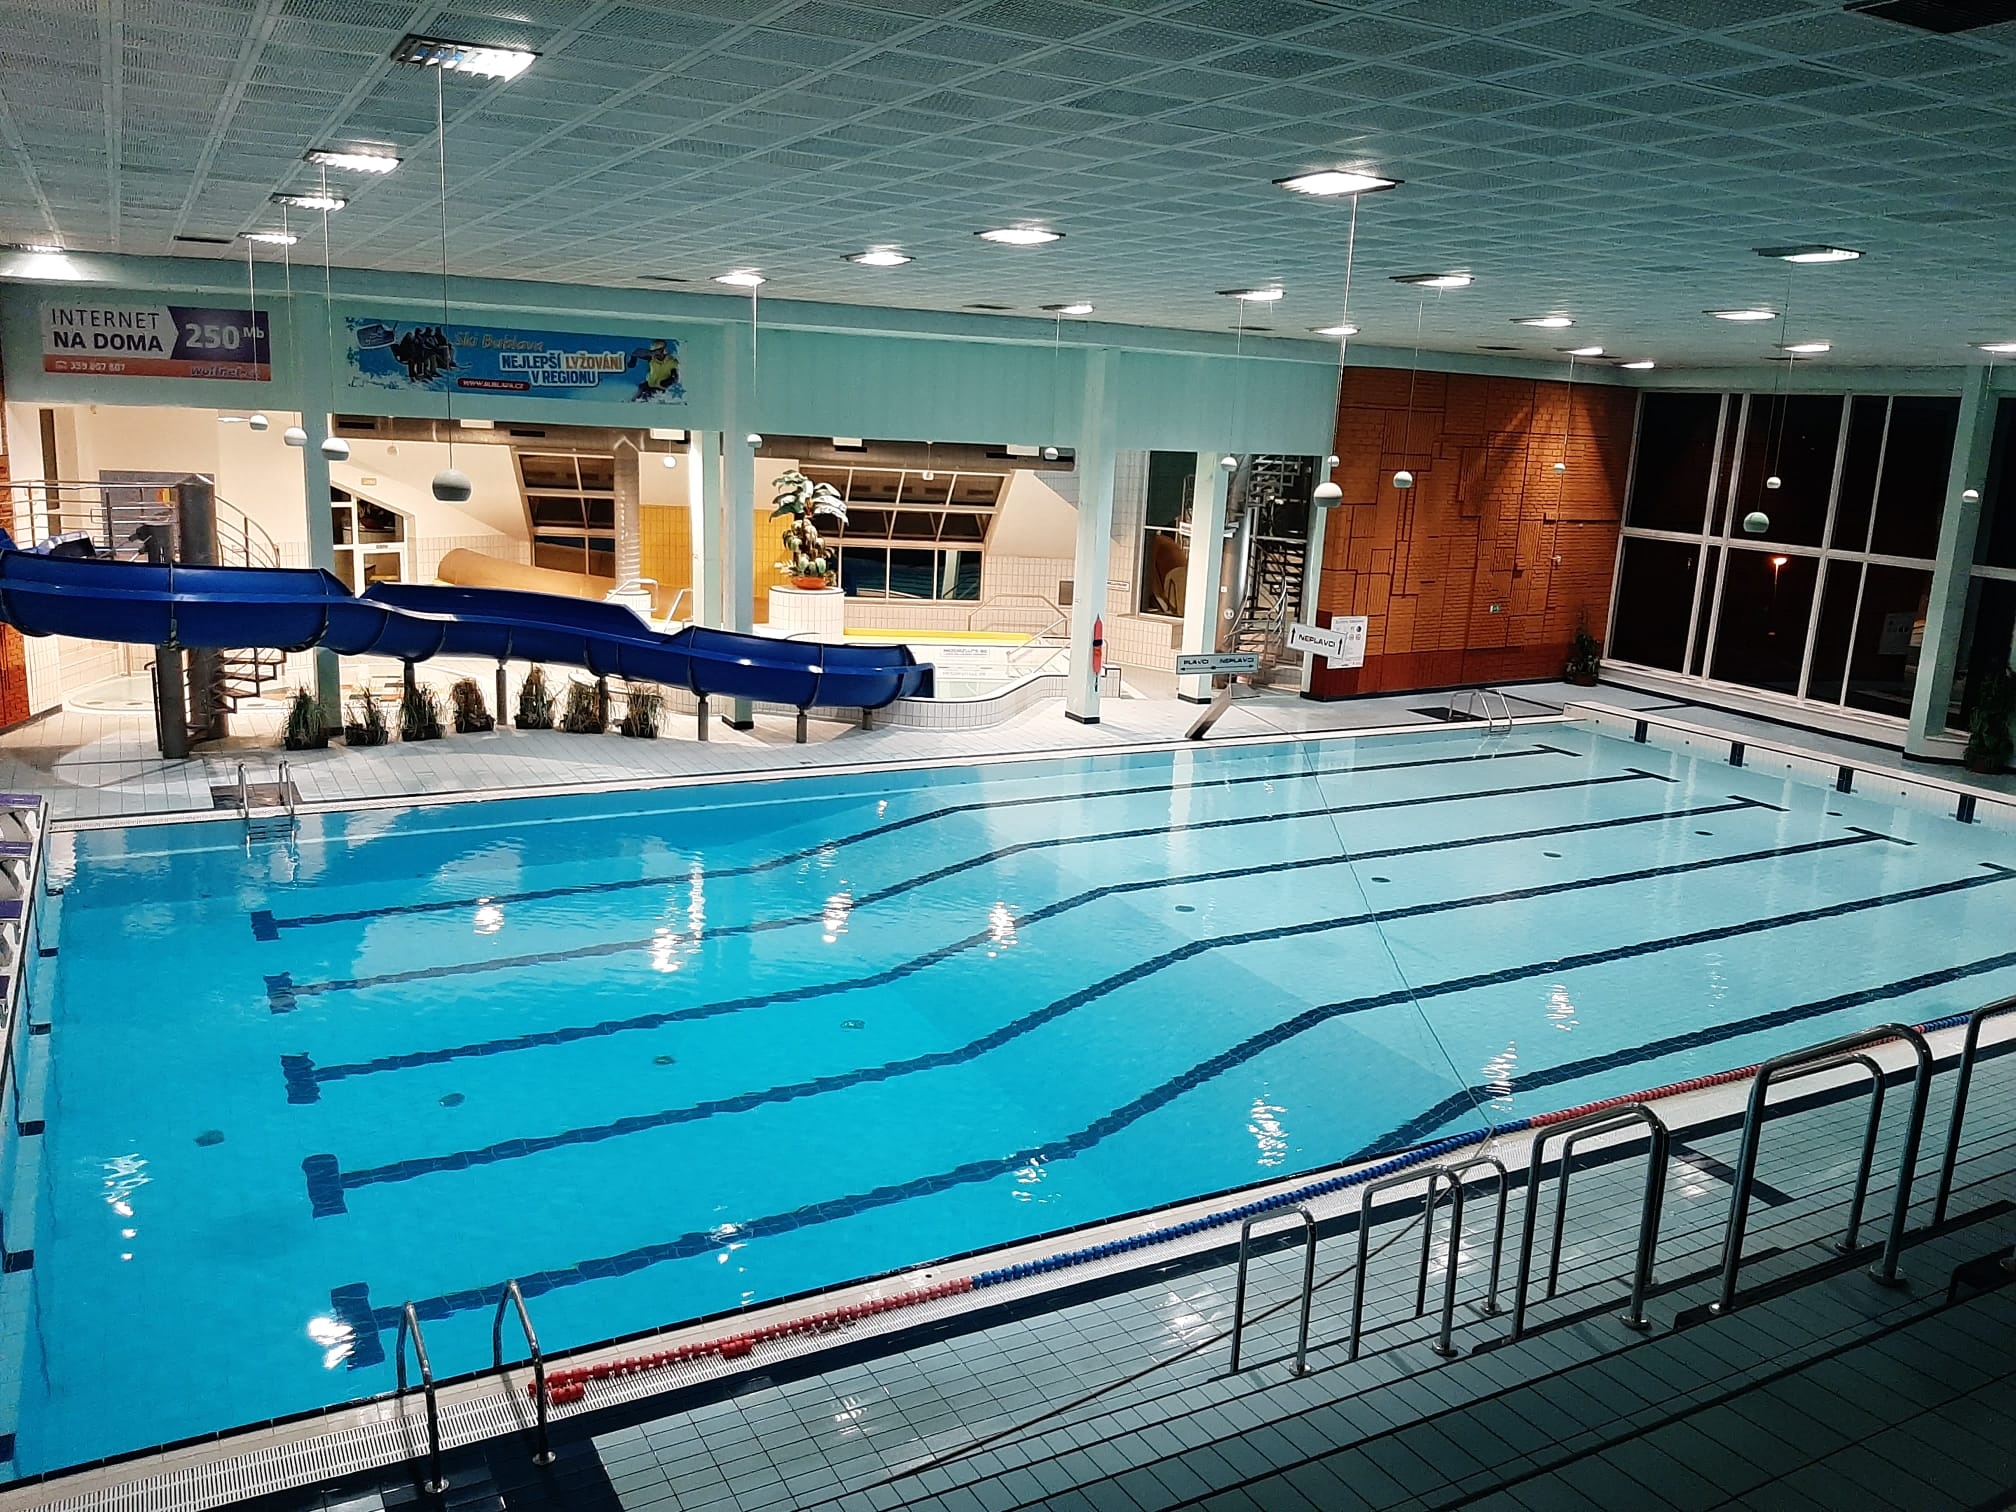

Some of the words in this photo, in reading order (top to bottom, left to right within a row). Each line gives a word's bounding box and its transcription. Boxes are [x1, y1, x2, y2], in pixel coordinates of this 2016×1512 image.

[52, 308, 160, 330] INTERNET
[54, 331, 85, 349] NA
[93, 333, 164, 352] DOMA
[185, 323, 240, 350] 250
[242, 327, 265, 340] Mb
[455, 331, 478, 346] Ski
[501, 352, 562, 369] NEJLEPŠÍ
[565, 353, 624, 370] LYŽOVÁNÍ
[531, 371, 539, 384] V
[542, 371, 596, 384] REGIONU
[1298, 634, 1336, 647] NEPLAVCI
